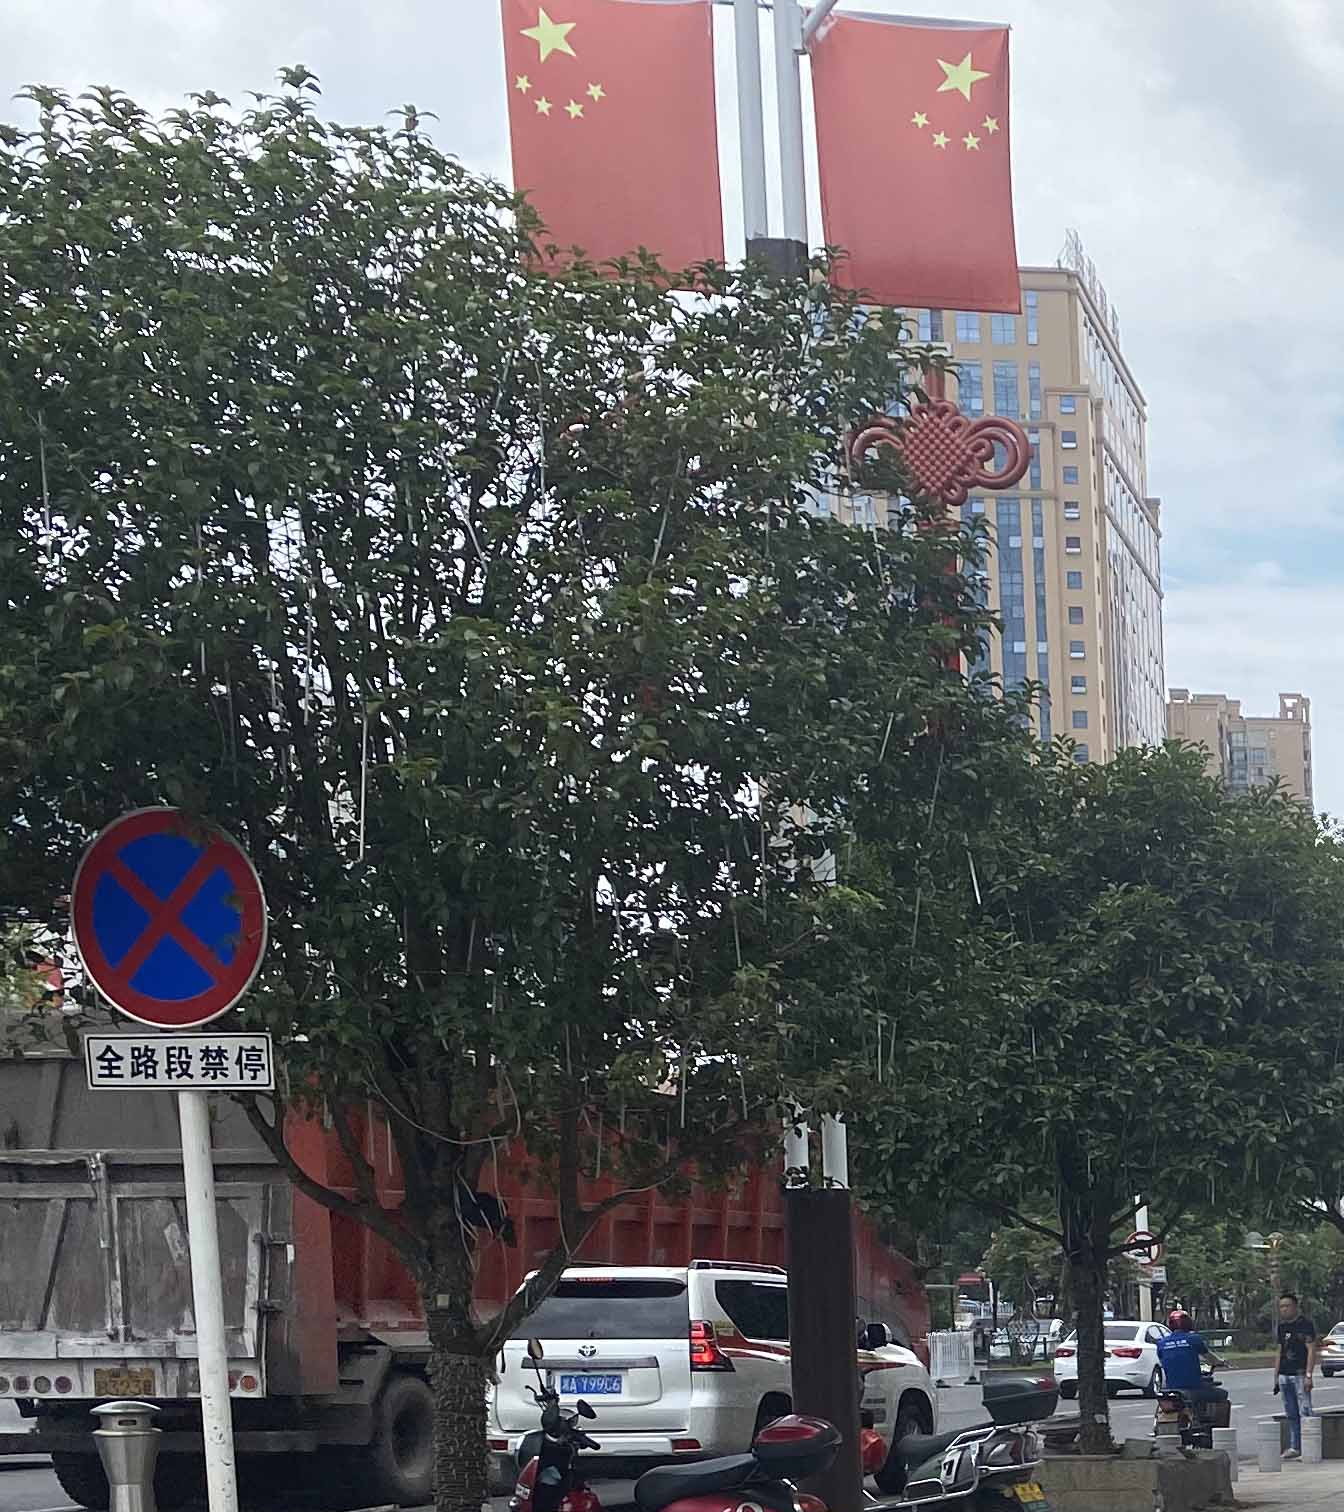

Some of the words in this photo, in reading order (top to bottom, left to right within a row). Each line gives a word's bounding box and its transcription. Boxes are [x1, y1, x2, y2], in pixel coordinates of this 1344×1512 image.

[95, 1044, 266, 1081] 全路段禁停
